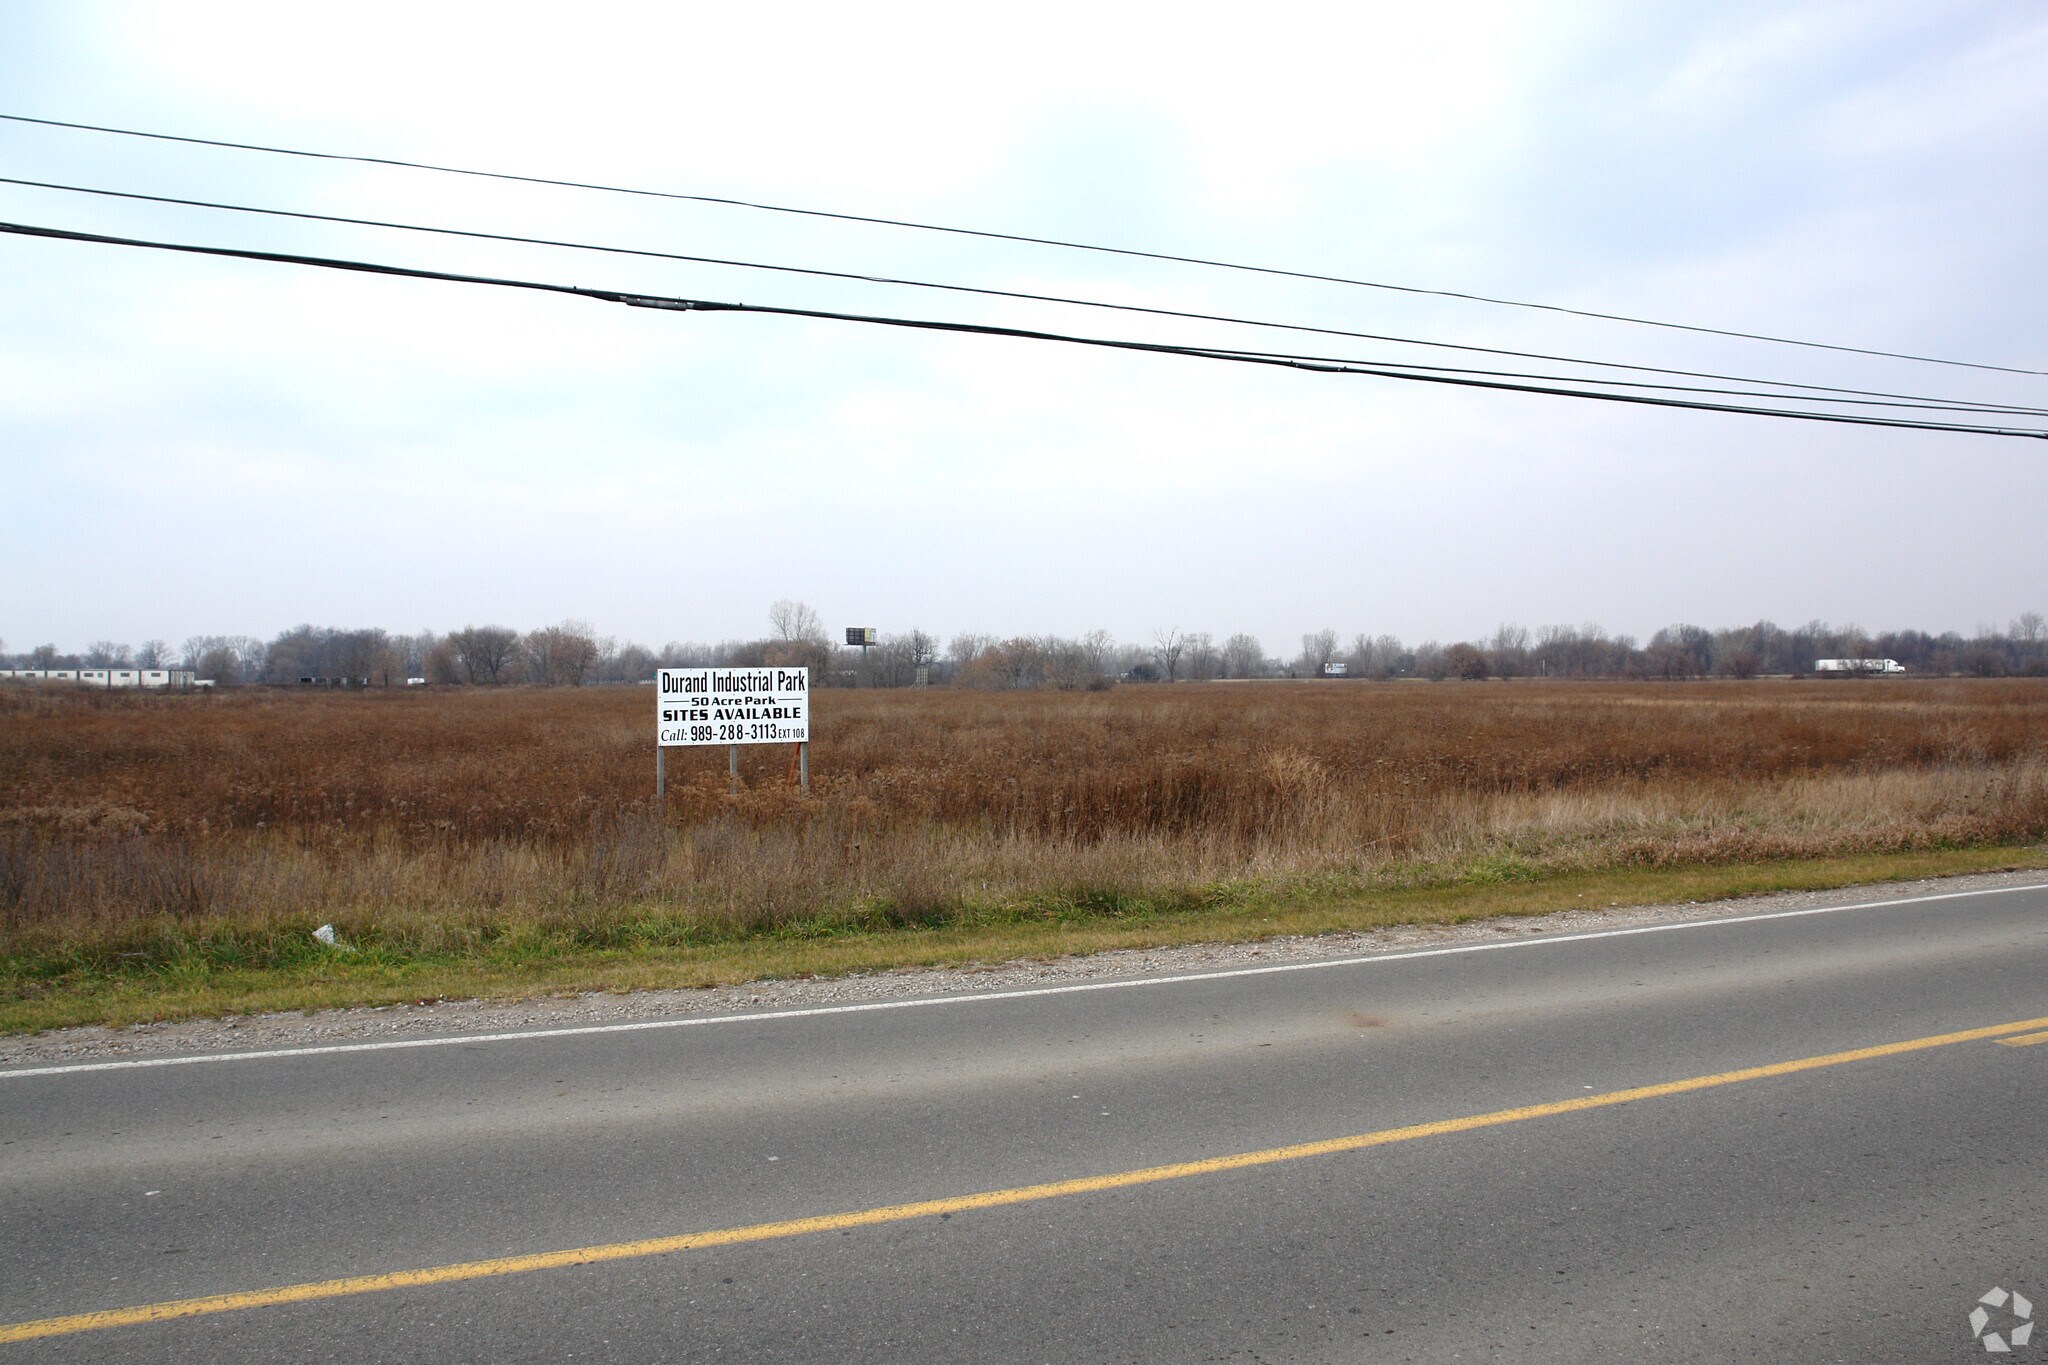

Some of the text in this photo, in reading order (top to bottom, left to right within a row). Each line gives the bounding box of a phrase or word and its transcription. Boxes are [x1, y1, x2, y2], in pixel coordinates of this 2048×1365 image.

[663, 670, 805, 693] Durand Industrial Park
[691, 696, 776, 706] 50 Acre Park
[663, 707, 801, 721] SITES AVAILABLE
[661, 729, 688, 741] Call:
[691, 724, 777, 741] 989-288-3113
[778, 728, 791, 738] EXT
